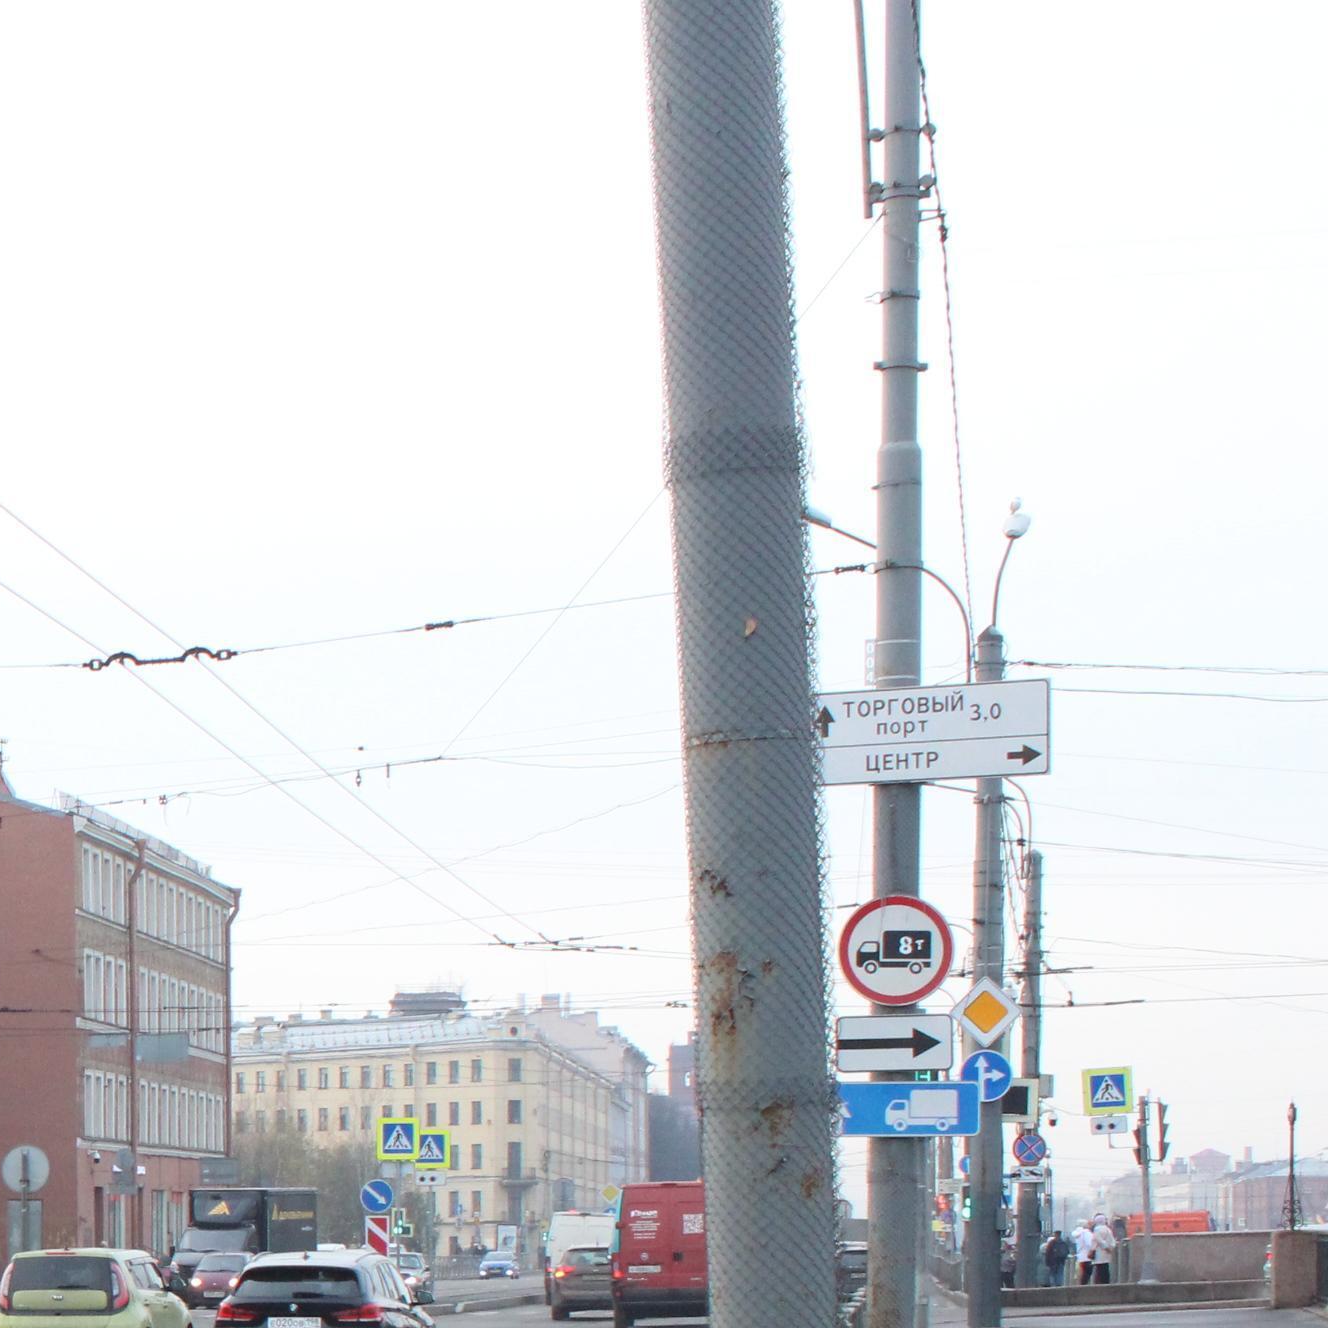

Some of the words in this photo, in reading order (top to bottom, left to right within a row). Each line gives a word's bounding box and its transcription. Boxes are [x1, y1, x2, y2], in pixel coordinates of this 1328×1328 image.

[842, 690, 964, 718] ТОРГОВЫЙ
[969, 703, 1001, 721] 3,0
[876, 720, 928, 737] порт
[865, 751, 939, 773] ЦЕНТР
